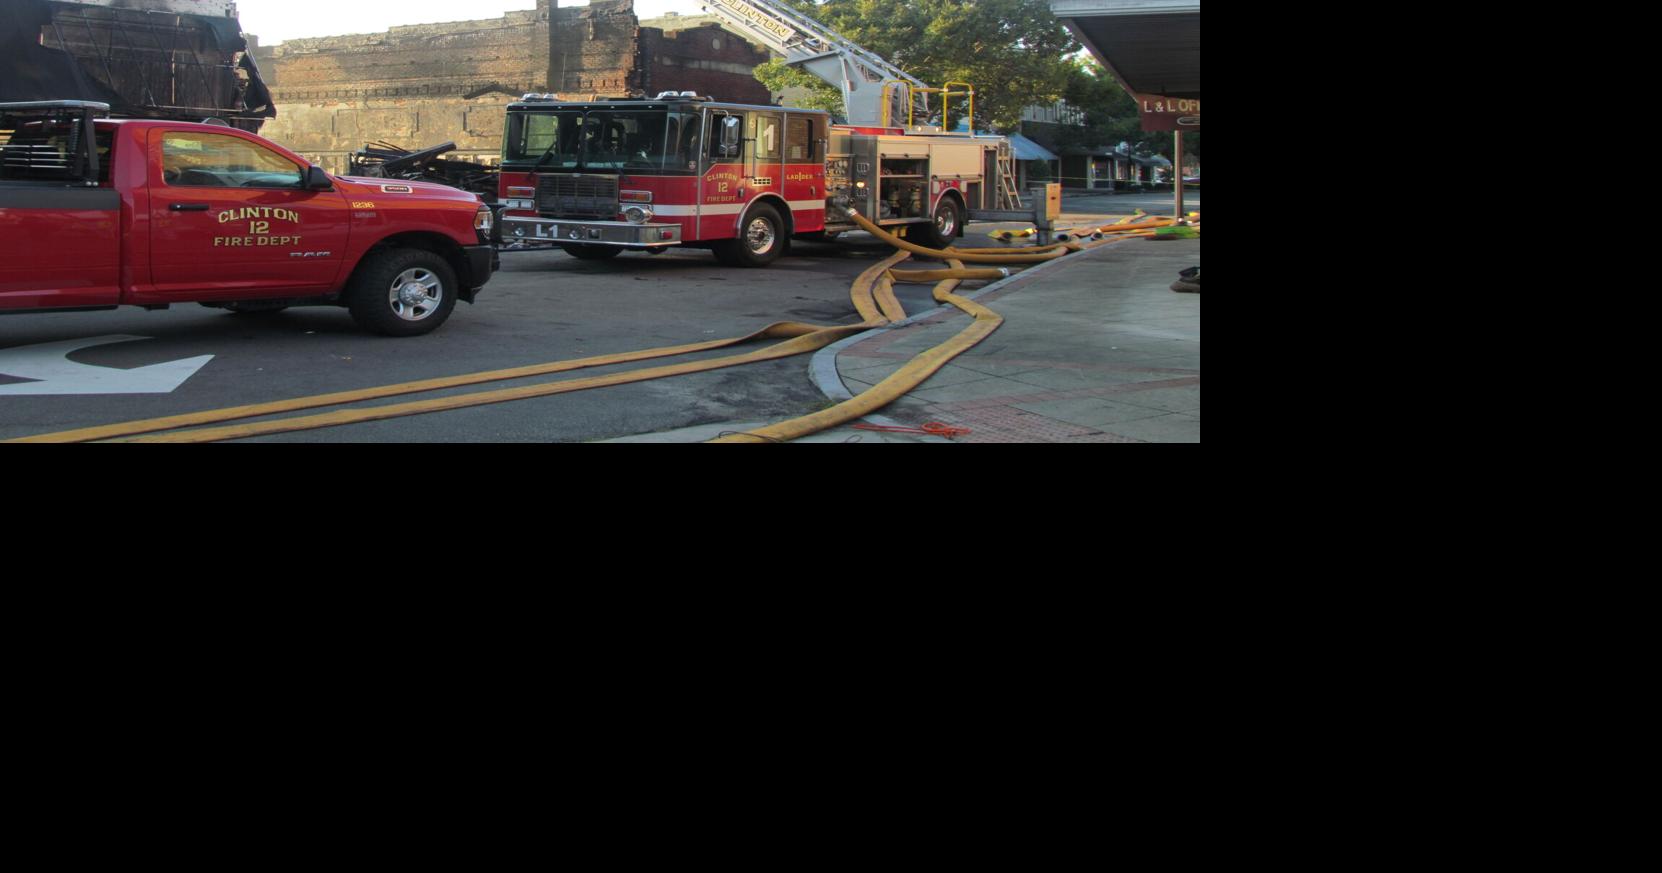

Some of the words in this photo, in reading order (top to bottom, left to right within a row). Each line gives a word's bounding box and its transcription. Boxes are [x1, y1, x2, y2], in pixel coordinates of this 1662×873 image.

[1144, 101, 1152, 112] L
[1155, 101, 1164, 112] &
[1167, 100, 1176, 112] L
[763, 124, 774, 151] 1
[706, 172, 738, 181] CLINTON
[718, 182, 728, 193] 12
[218, 207, 299, 223] CLINTON
[249, 221, 269, 234] 12
[536, 224, 558, 238] L1
[213, 236, 252, 246] FIRE
[257, 236, 301, 246] DEPT
